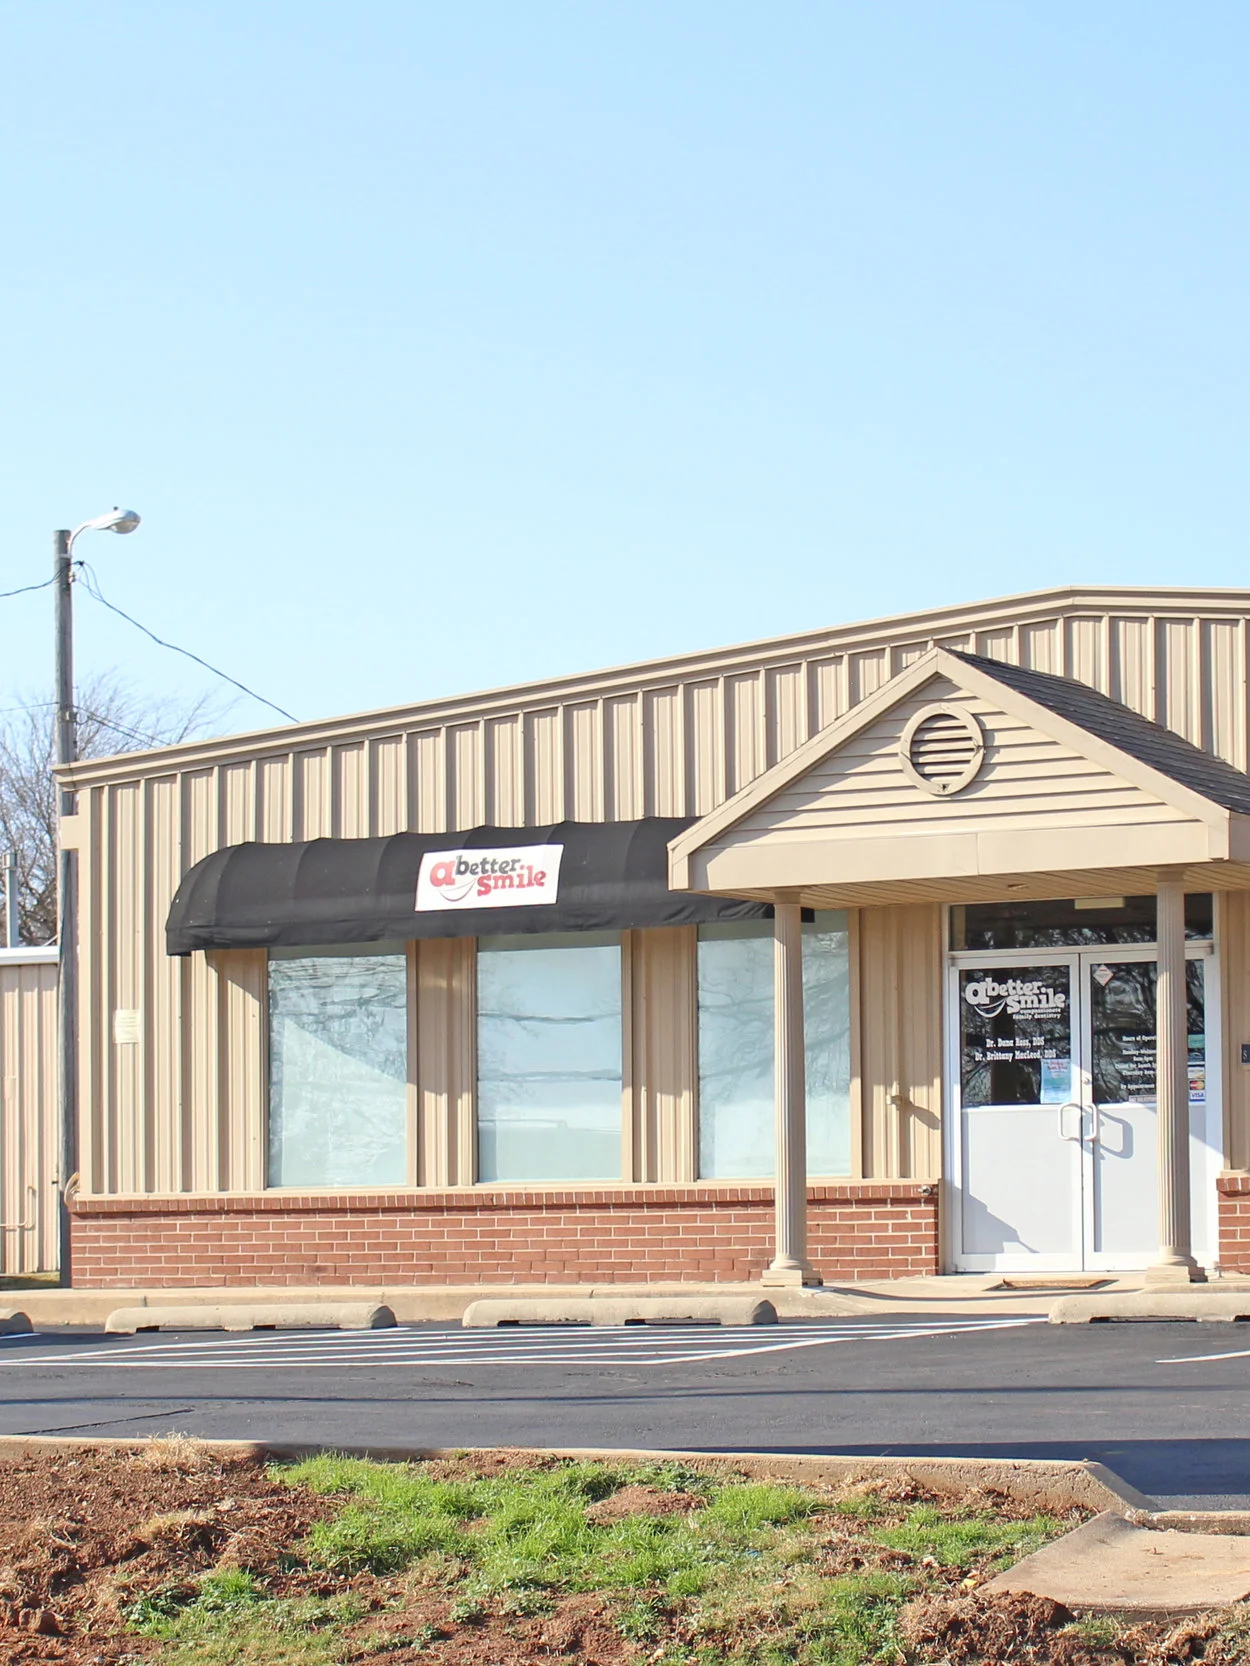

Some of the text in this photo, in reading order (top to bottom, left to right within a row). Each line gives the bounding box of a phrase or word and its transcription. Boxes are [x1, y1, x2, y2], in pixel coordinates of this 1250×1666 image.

[429, 855, 521, 887] a better
[477, 865, 547, 897] smile
[965, 977, 1043, 1005] a better
[1006, 987, 1066, 1014] smile
[974, 1051, 985, 1061] Dr.
[986, 1050, 1013, 1062] Brittany
[1044, 1048, 1057, 1058] DDS
[985, 1038, 996, 1048] Dr.
[1032, 1036, 1045, 1046] DDS
